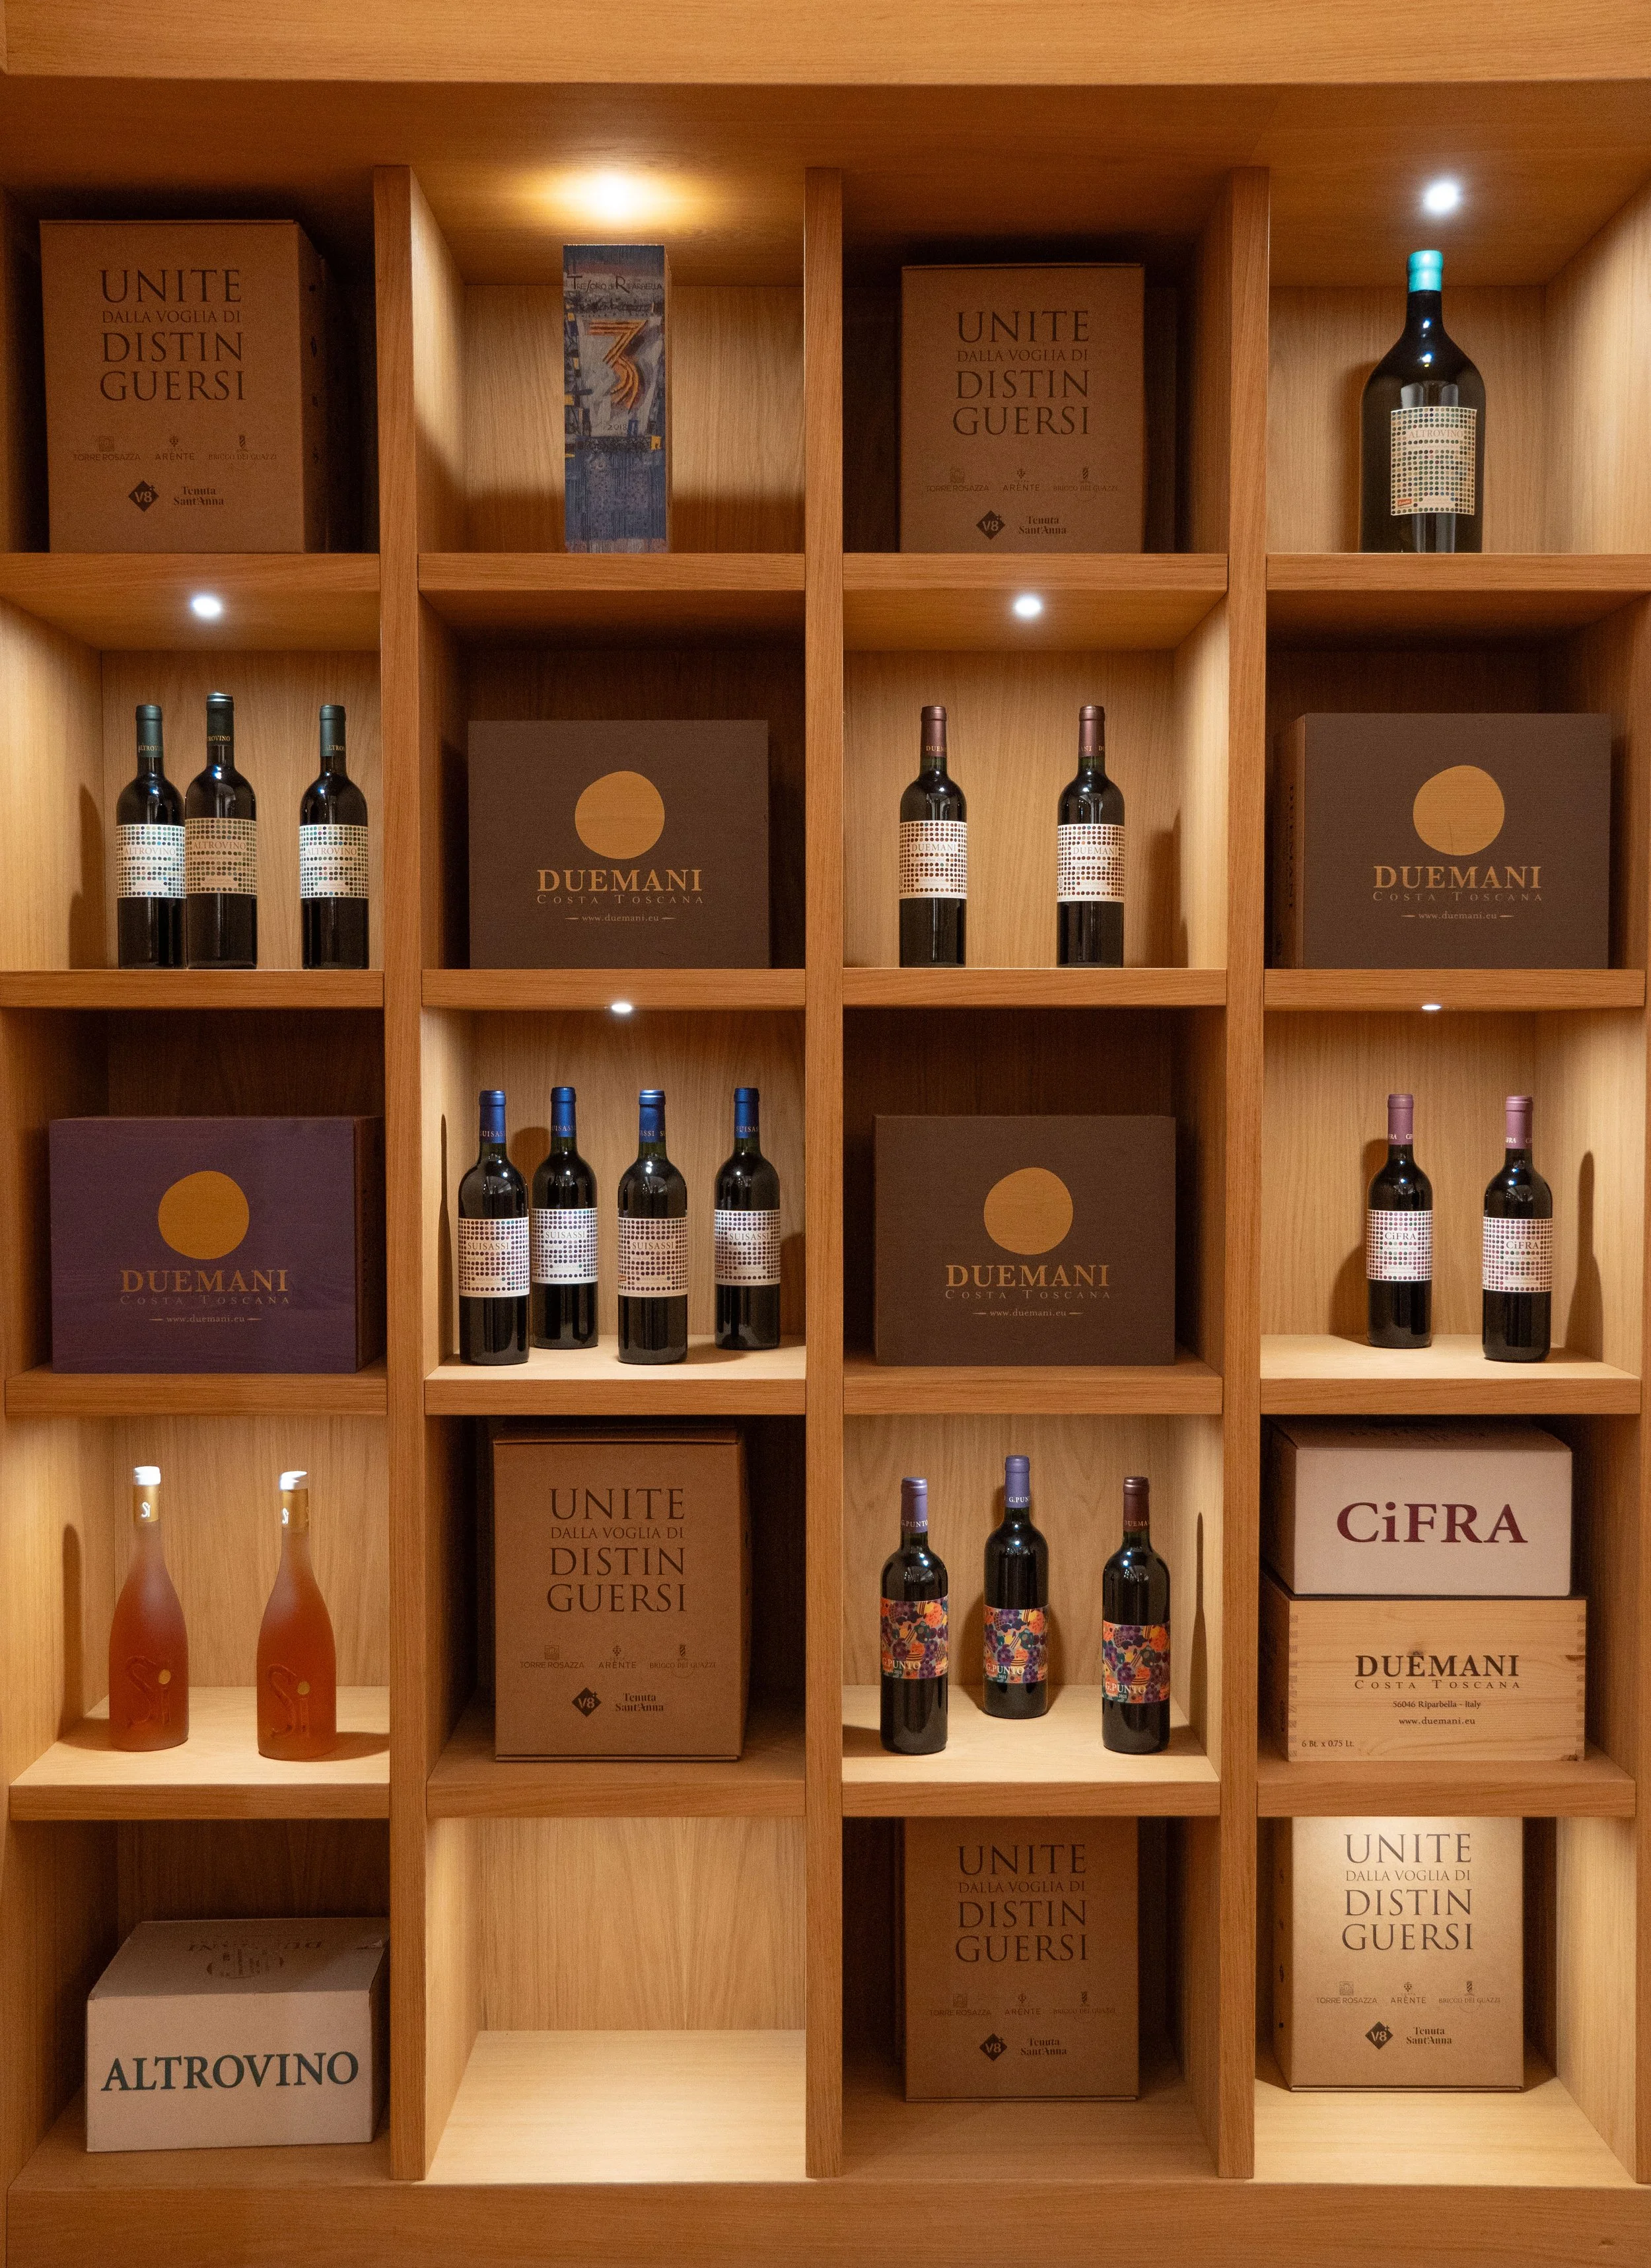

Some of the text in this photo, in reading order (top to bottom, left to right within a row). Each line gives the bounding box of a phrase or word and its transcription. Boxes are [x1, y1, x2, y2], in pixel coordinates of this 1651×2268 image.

[98, 269, 242, 303] UNITE
[102, 309, 241, 324] DALLA VOGLIA DI
[956, 310, 1090, 343] UNITE
[101, 331, 244, 363] DISTIN
[957, 349, 1088, 362] DALLA VOGLIA DI
[99, 369, 248, 402] GUERSI
[955, 369, 1090, 399] DISTIN
[952, 405, 1090, 436] GUERSI
[1408, 429, 1463, 439] ALTROVINO
[181, 486, 217, 495] Tenuta
[1026, 515, 1060, 524] Tenuta
[123, 847, 176, 857] ALTROVINO
[193, 841, 246, 851] ALTROVINO
[305, 847, 357, 856] ALTROVINO
[911, 843, 958, 852] DUEMANI
[1072, 846, 1117, 856] DUEMANI
[536, 868, 703, 893] DUEMANI
[1372, 865, 1543, 889] DUEMANI
[536, 894, 705, 905] COSTA TOSCANA
[1372, 890, 1543, 902] COSTA TOSCANA
[581, 913, 660, 923] www.duemani.eu
[1418, 910, 1498, 921] www.duemani.eu
[545, 1231, 586, 1240] SUISASSI
[729, 1232, 769, 1241] SUISASSI
[1384, 1231, 1417, 1240] CiFRA
[467, 1242, 509, 1250] SUISASSI
[631, 1241, 674, 1250] SUISASSI
[1506, 1240, 1539, 1250] CiFRA
[119, 1269, 289, 1293] DUEMANI
[945, 1264, 1110, 1288] DUEMANI
[118, 1294, 291, 1306] COSTA TOSCANA
[944, 1289, 1111, 1300] COSTA TOSCANA
[165, 1314, 246, 1324] www.duemani.eu
[989, 1308, 1068, 1318] www.duemani.eu
[549, 1487, 685, 1520] UNITE
[1335, 1501, 1529, 1544] CiFRA
[551, 1526, 684, 1539] DALLA VOGLIA DI
[549, 1546, 685, 1576] DISTIN
[546, 1582, 687, 1613] GUERSI
[882, 1657, 921, 1670] G.PUNTO
[986, 1662, 1024, 1675] G.PUNTO
[1354, 1654, 1521, 1678] DUEMANI
[1106, 1681, 1146, 1694] G.PUNTO
[1353, 1678, 1522, 1689] COSTA TOSCANA
[622, 1693, 656, 1702] Tenuta
[1417, 1700, 1457, 1709] Riparbella
[1465, 1700, 1481, 1709] Italy
[1398, 1717, 1477, 1726] www.duemani.eu
[1343, 1833, 1472, 1864] UNITE
[957, 1843, 1087, 1876] UNITE
[1345, 1869, 1471, 1882] DALLA VOGLIA DI
[958, 1880, 1086, 1894] DALLA VOGLIA DI
[1343, 1888, 1473, 1916] DISTIN
[957, 1899, 1087, 1929] DISTIN
[1341, 1923, 1475, 1951] GUERSI
[955, 1933, 1089, 1963] GUERSI
[1414, 2026, 1445, 2035] Tenuta
[1028, 2038, 1060, 2046] Tenuta
[100, 2049, 360, 2092] ALTROVINO
